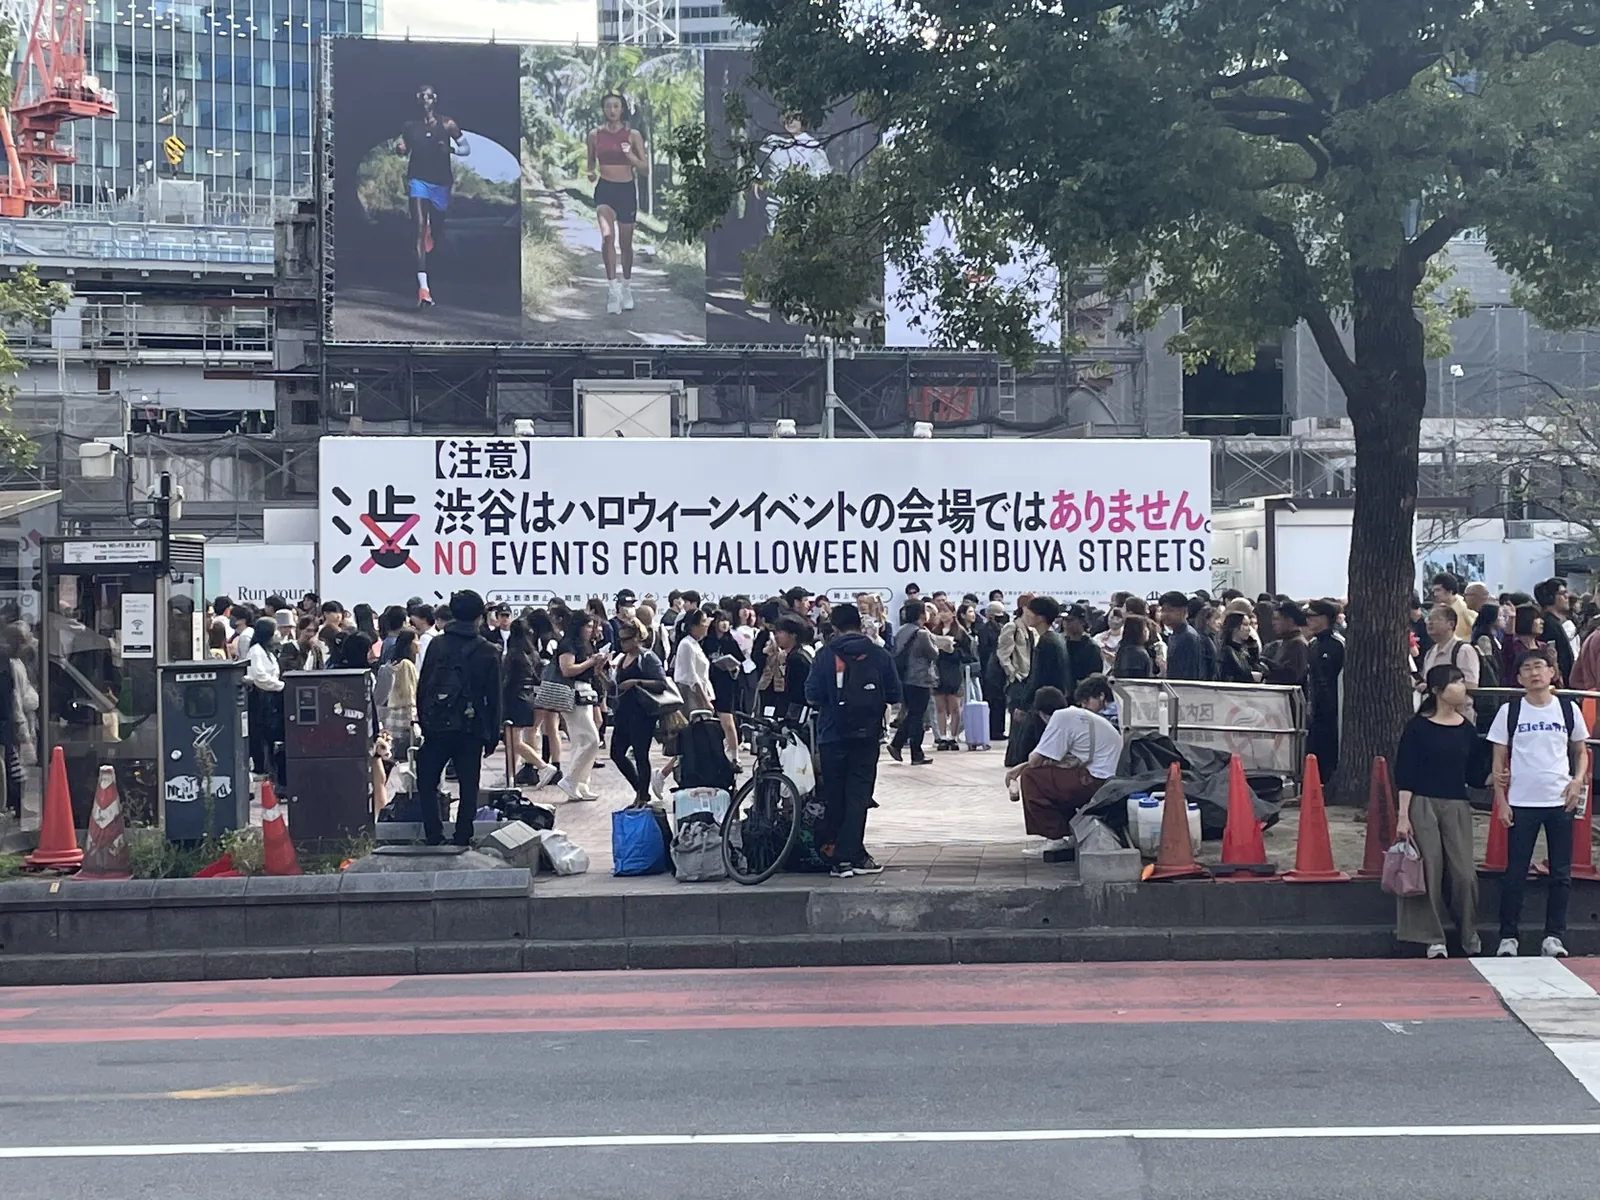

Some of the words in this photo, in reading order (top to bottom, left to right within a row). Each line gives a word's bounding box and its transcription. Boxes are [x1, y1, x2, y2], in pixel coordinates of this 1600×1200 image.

[436, 441, 530, 479] 【注意】
[435, 539, 477, 575] NO
[492, 539, 609, 576] EVENTS
[624, 539, 679, 575] FOR
[694, 539, 878, 574] HALLOWEEN
[894, 538, 931, 573] ON
[940, 538, 1066, 573] SHIBUYA
[238, 586, 267, 601] Run
